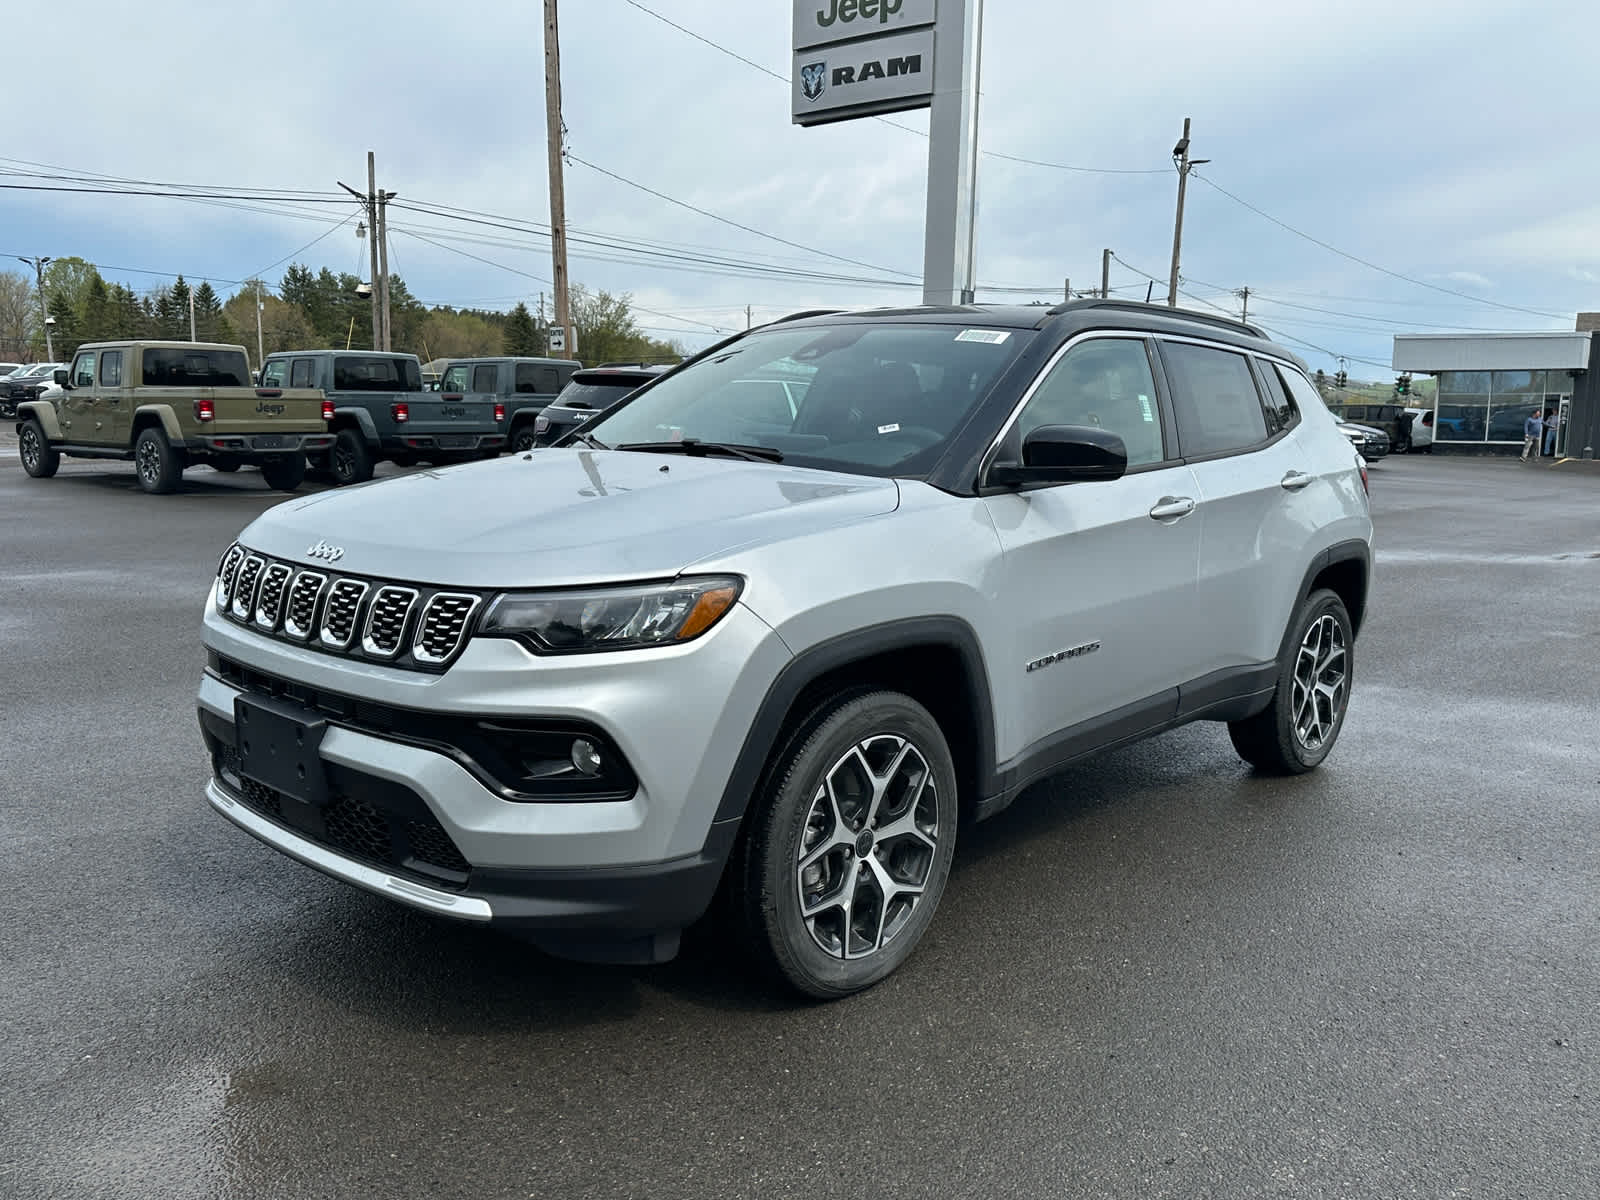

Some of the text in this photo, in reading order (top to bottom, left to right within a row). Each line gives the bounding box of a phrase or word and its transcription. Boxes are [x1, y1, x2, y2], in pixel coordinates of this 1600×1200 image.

[817, 0, 902, 27] Jeep
[832, 54, 921, 86] RAM
[256, 401, 285, 415] Jeep
[441, 405, 465, 418] Jeep
[307, 540, 344, 564] Jeep
[1026, 640, 1100, 672] COMPASS
